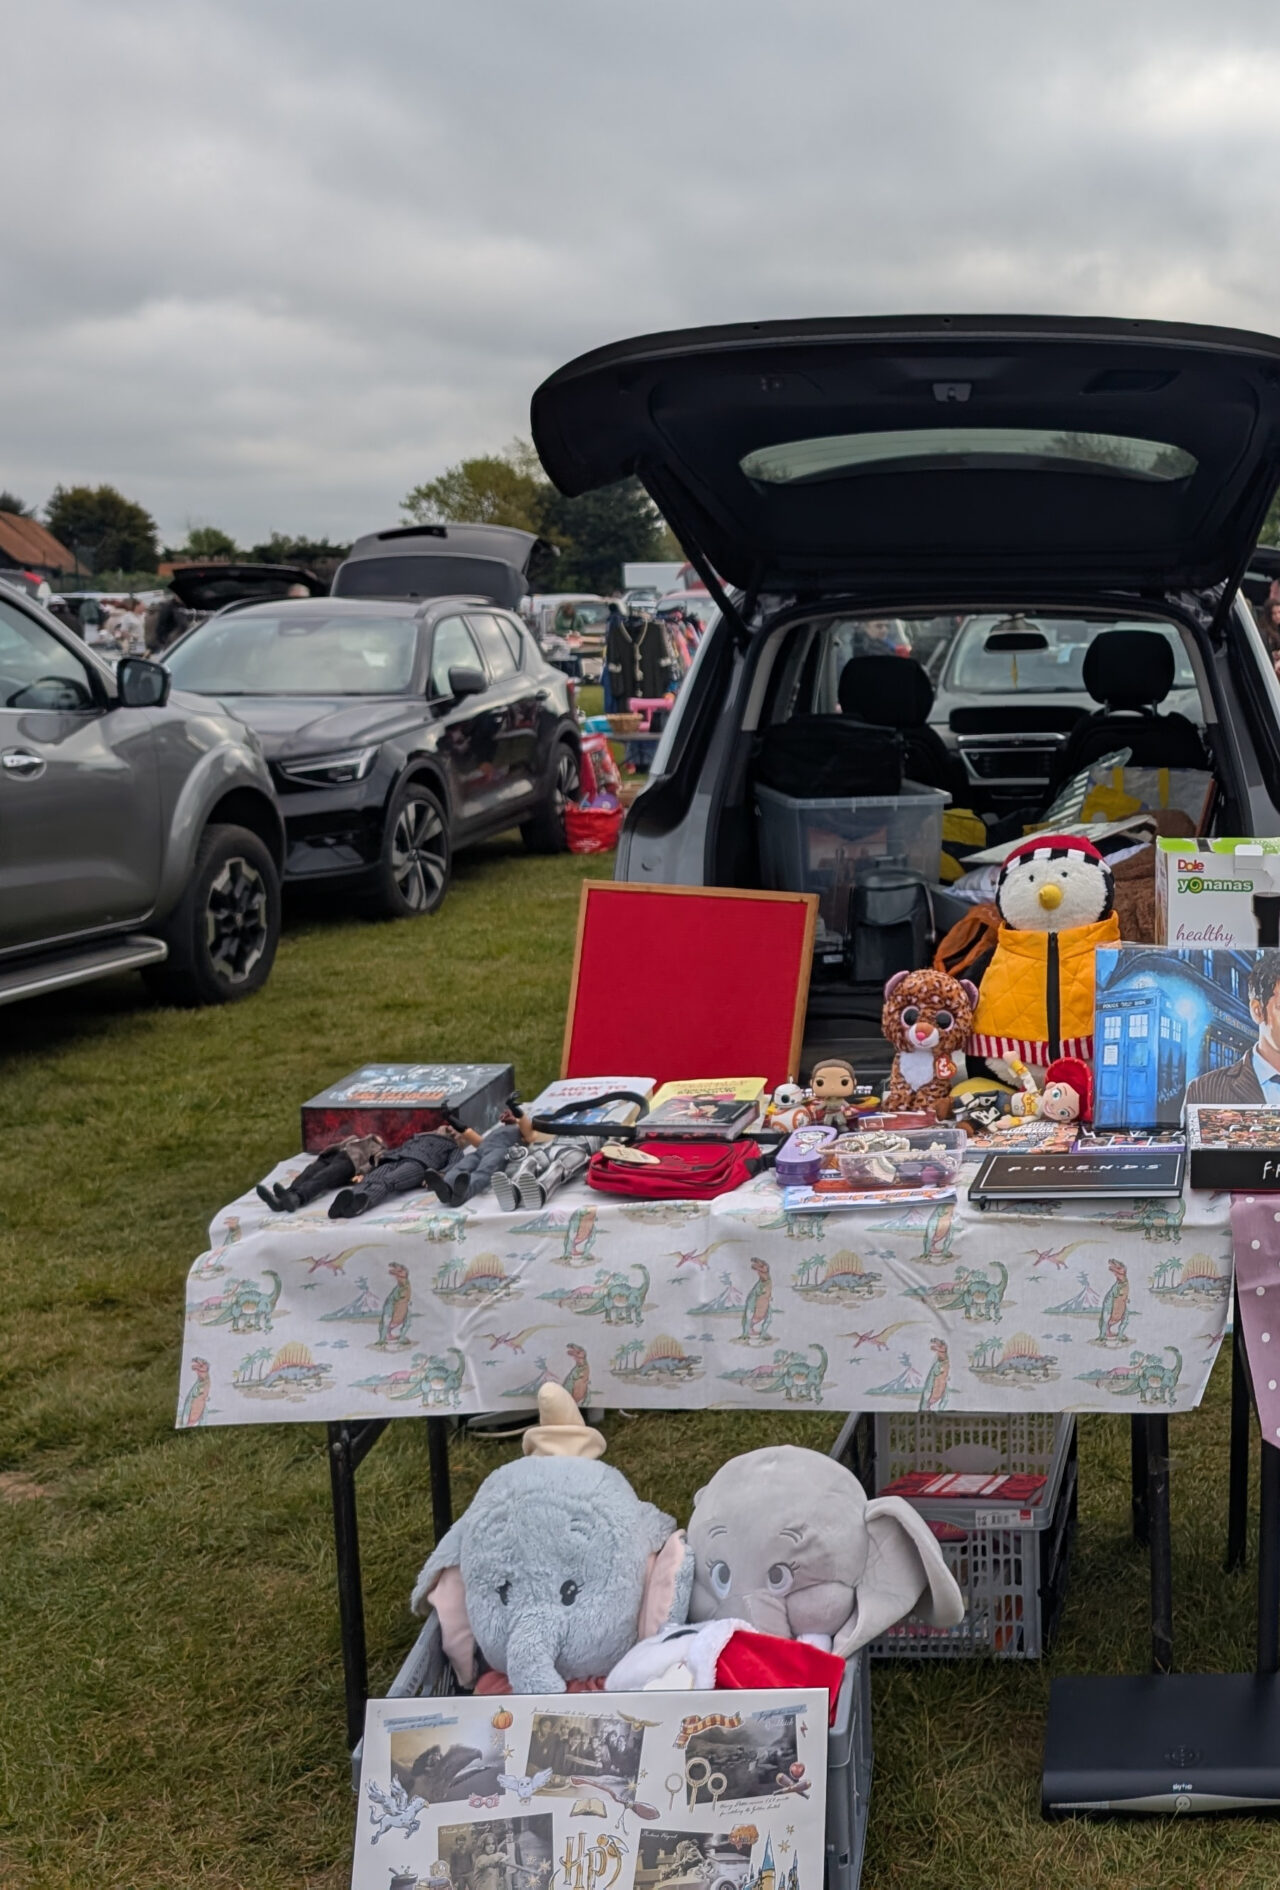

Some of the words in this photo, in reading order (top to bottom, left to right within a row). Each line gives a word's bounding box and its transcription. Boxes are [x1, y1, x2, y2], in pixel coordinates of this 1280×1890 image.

[1178, 859, 1204, 872] Dole
[1178, 877, 1254, 893] yonanas
[1176, 924, 1235, 947] healthy
